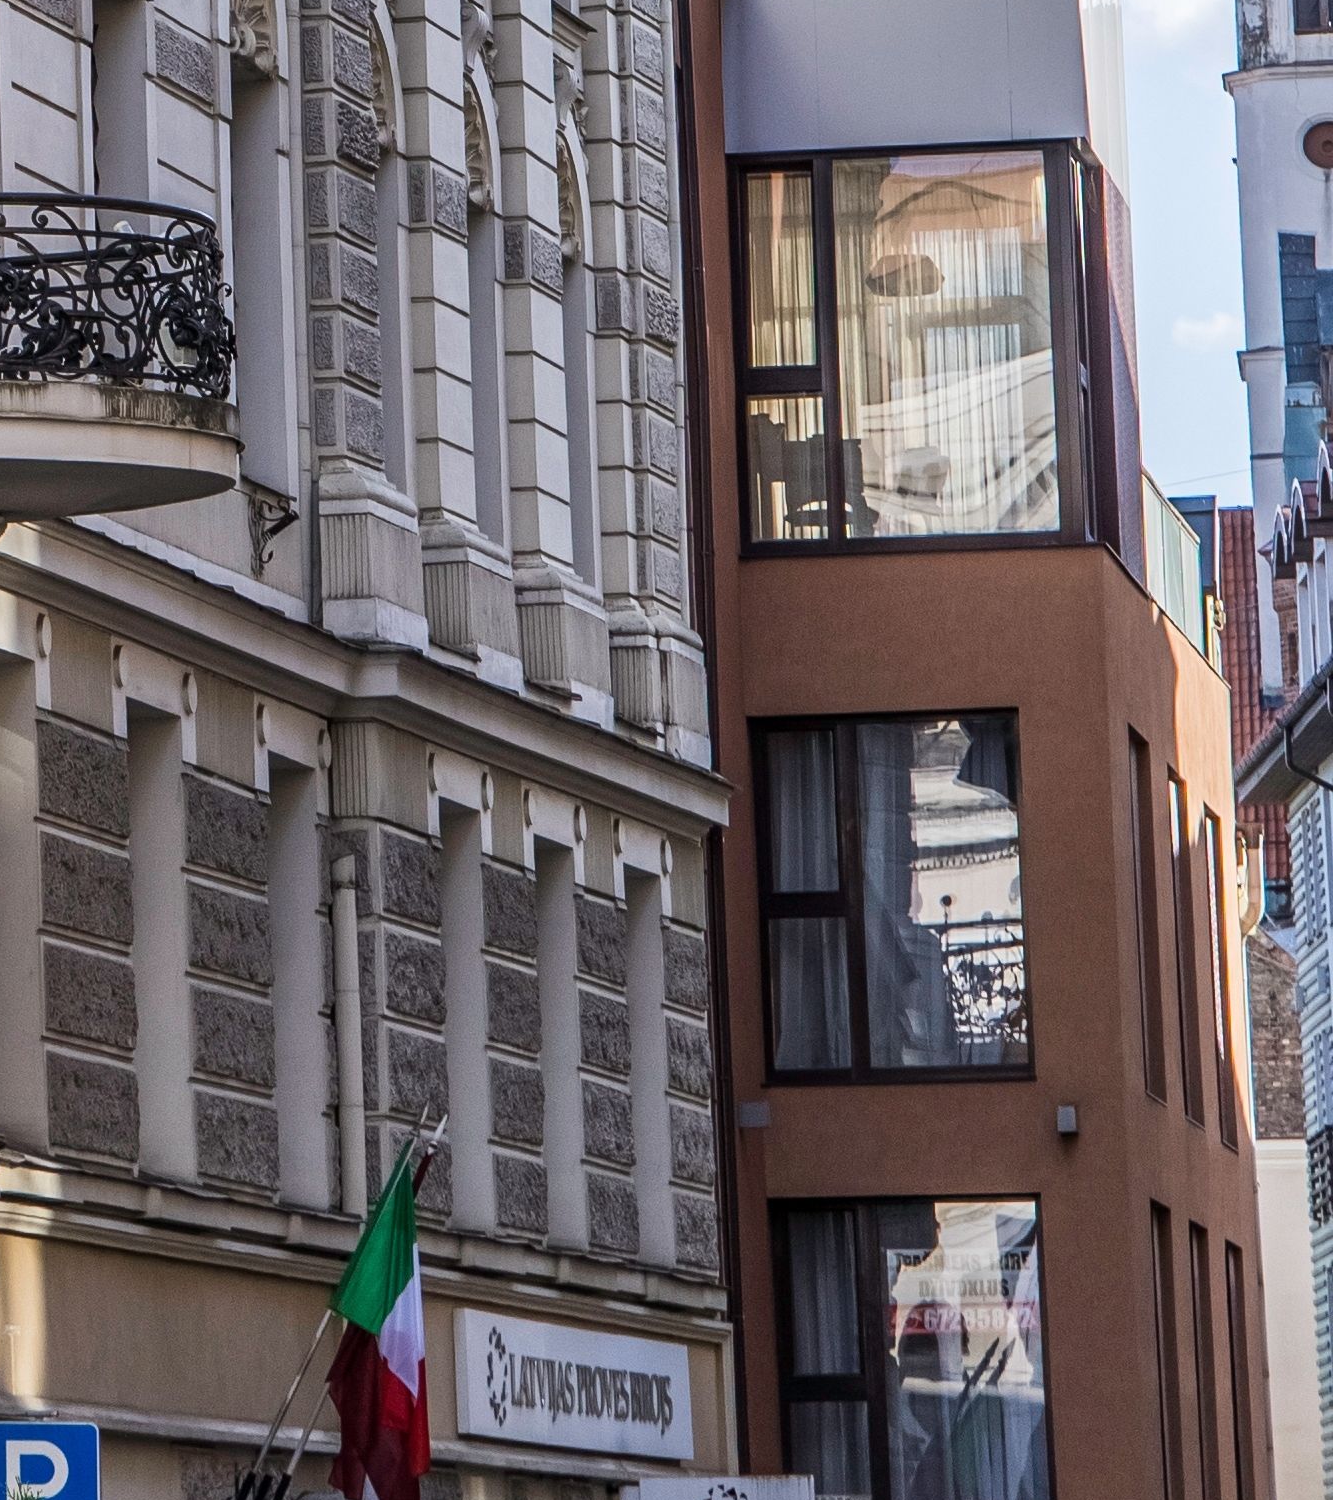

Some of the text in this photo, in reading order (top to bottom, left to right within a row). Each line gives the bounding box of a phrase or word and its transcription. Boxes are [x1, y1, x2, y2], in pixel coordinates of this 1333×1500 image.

[923, 1307, 1032, 1331] 6728587
[509, 1352, 575, 1424] LATVIJAS
[575, 1363, 630, 1424] PROVES
